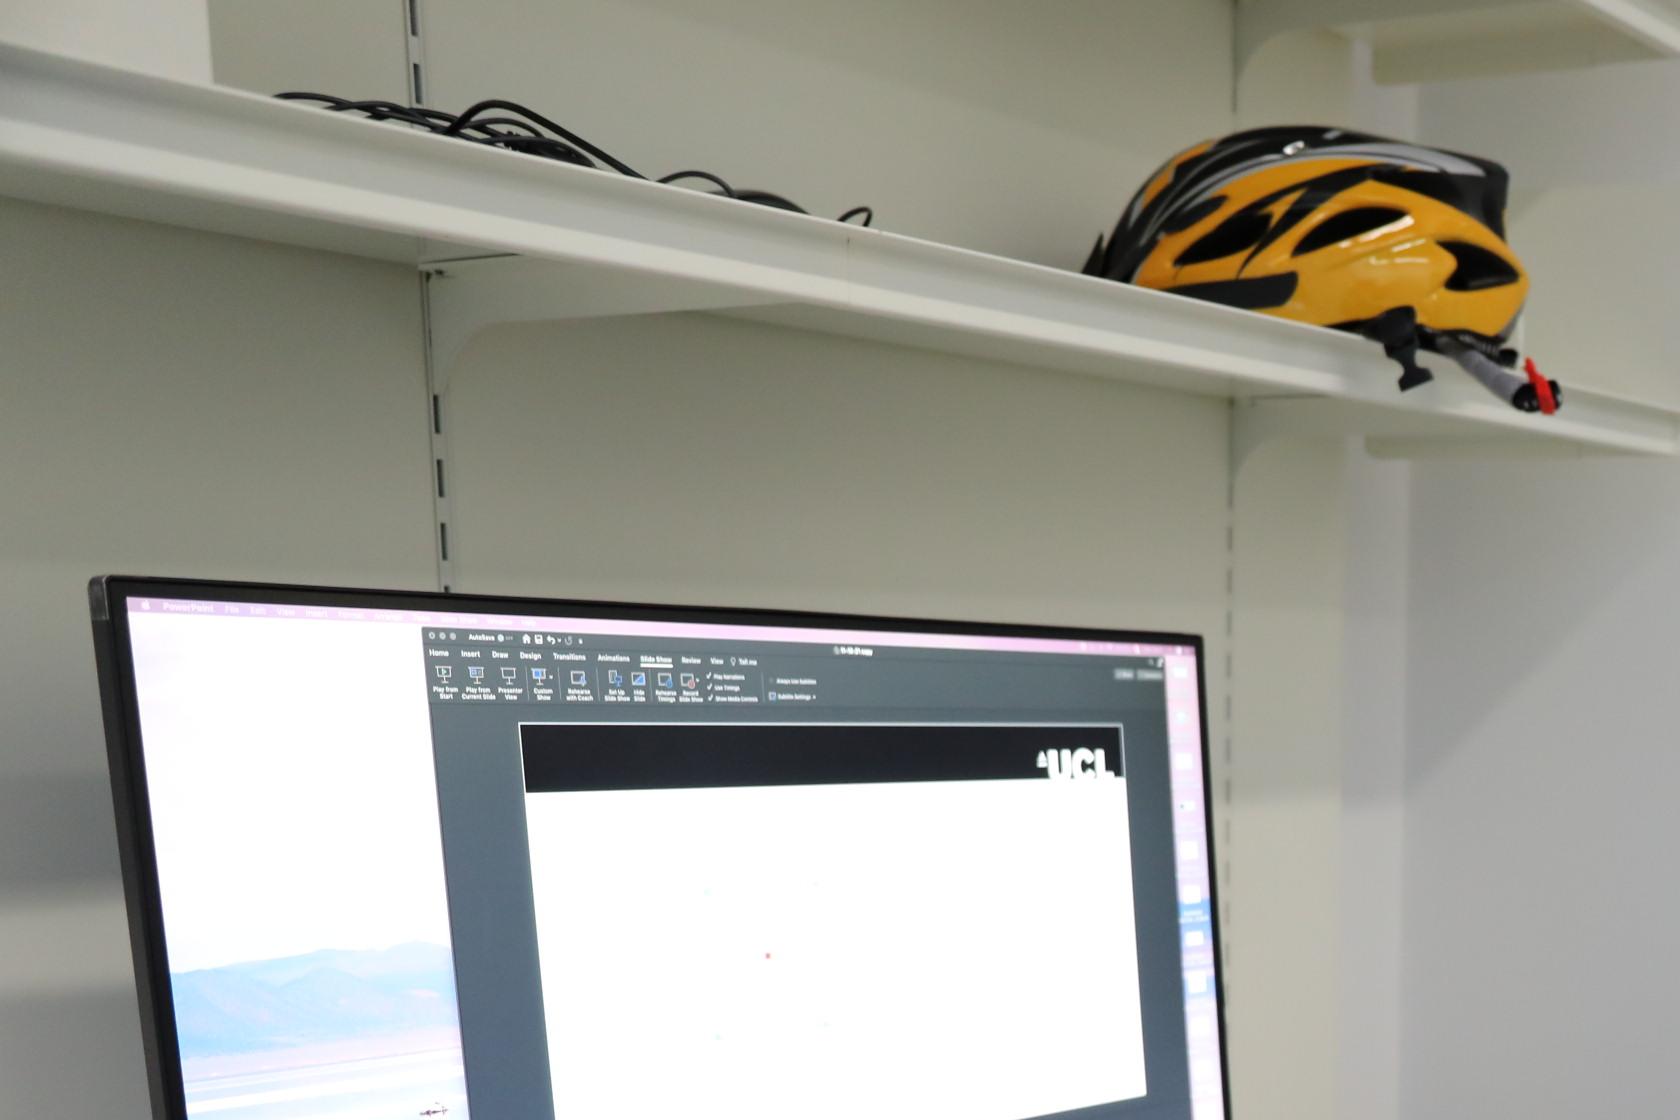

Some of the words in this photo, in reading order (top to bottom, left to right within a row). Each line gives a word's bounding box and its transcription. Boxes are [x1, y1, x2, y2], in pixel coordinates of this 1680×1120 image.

[429, 649, 449, 657] Home
[461, 650, 480, 658] Insert
[492, 650, 508, 659] Draw
[520, 651, 541, 660] Design
[553, 652, 586, 661] Transitions
[598, 654, 630, 662] Animations
[681, 656, 701, 664] Review
[710, 657, 724, 665] View
[1046, 747, 1115, 780] UCL
